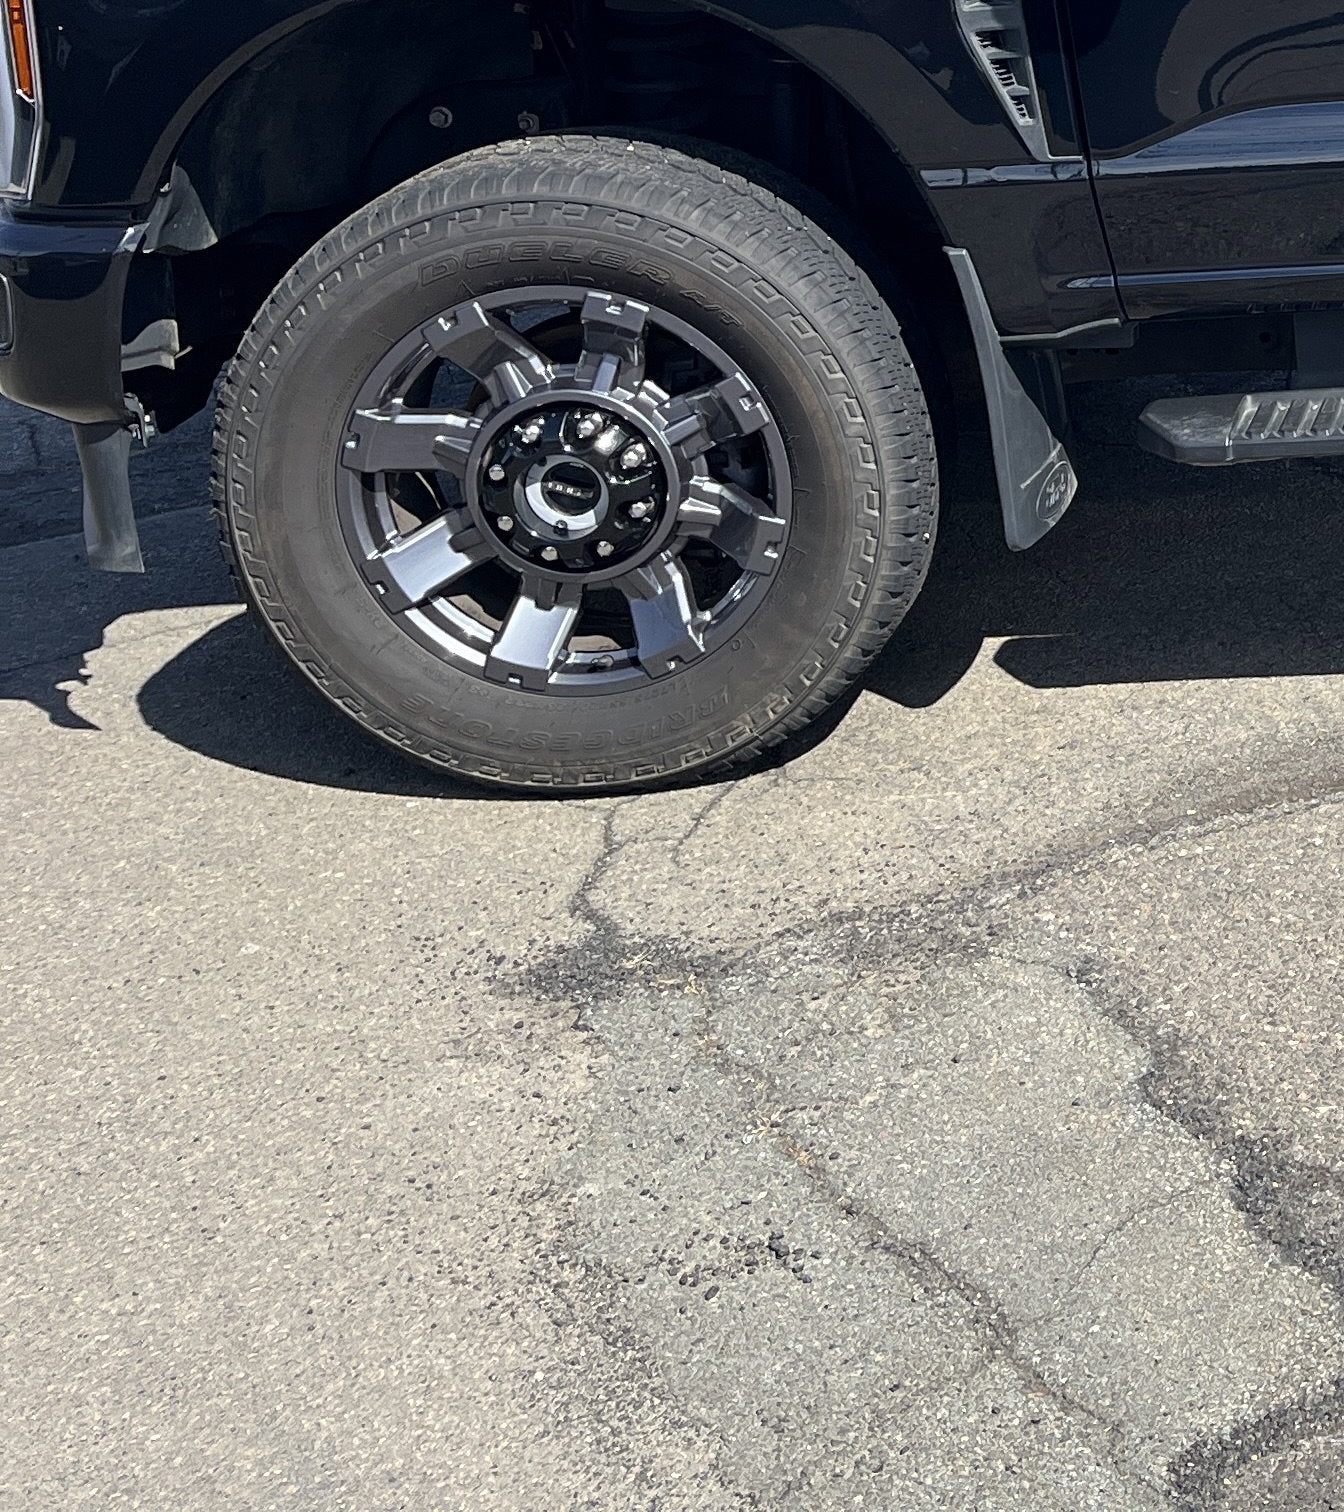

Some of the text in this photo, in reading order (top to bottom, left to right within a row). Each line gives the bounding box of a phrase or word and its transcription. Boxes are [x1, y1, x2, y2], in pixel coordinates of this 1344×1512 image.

[420, 241, 744, 329] DUELER A/T
[400, 687, 735, 754] BRIDGESTONE
